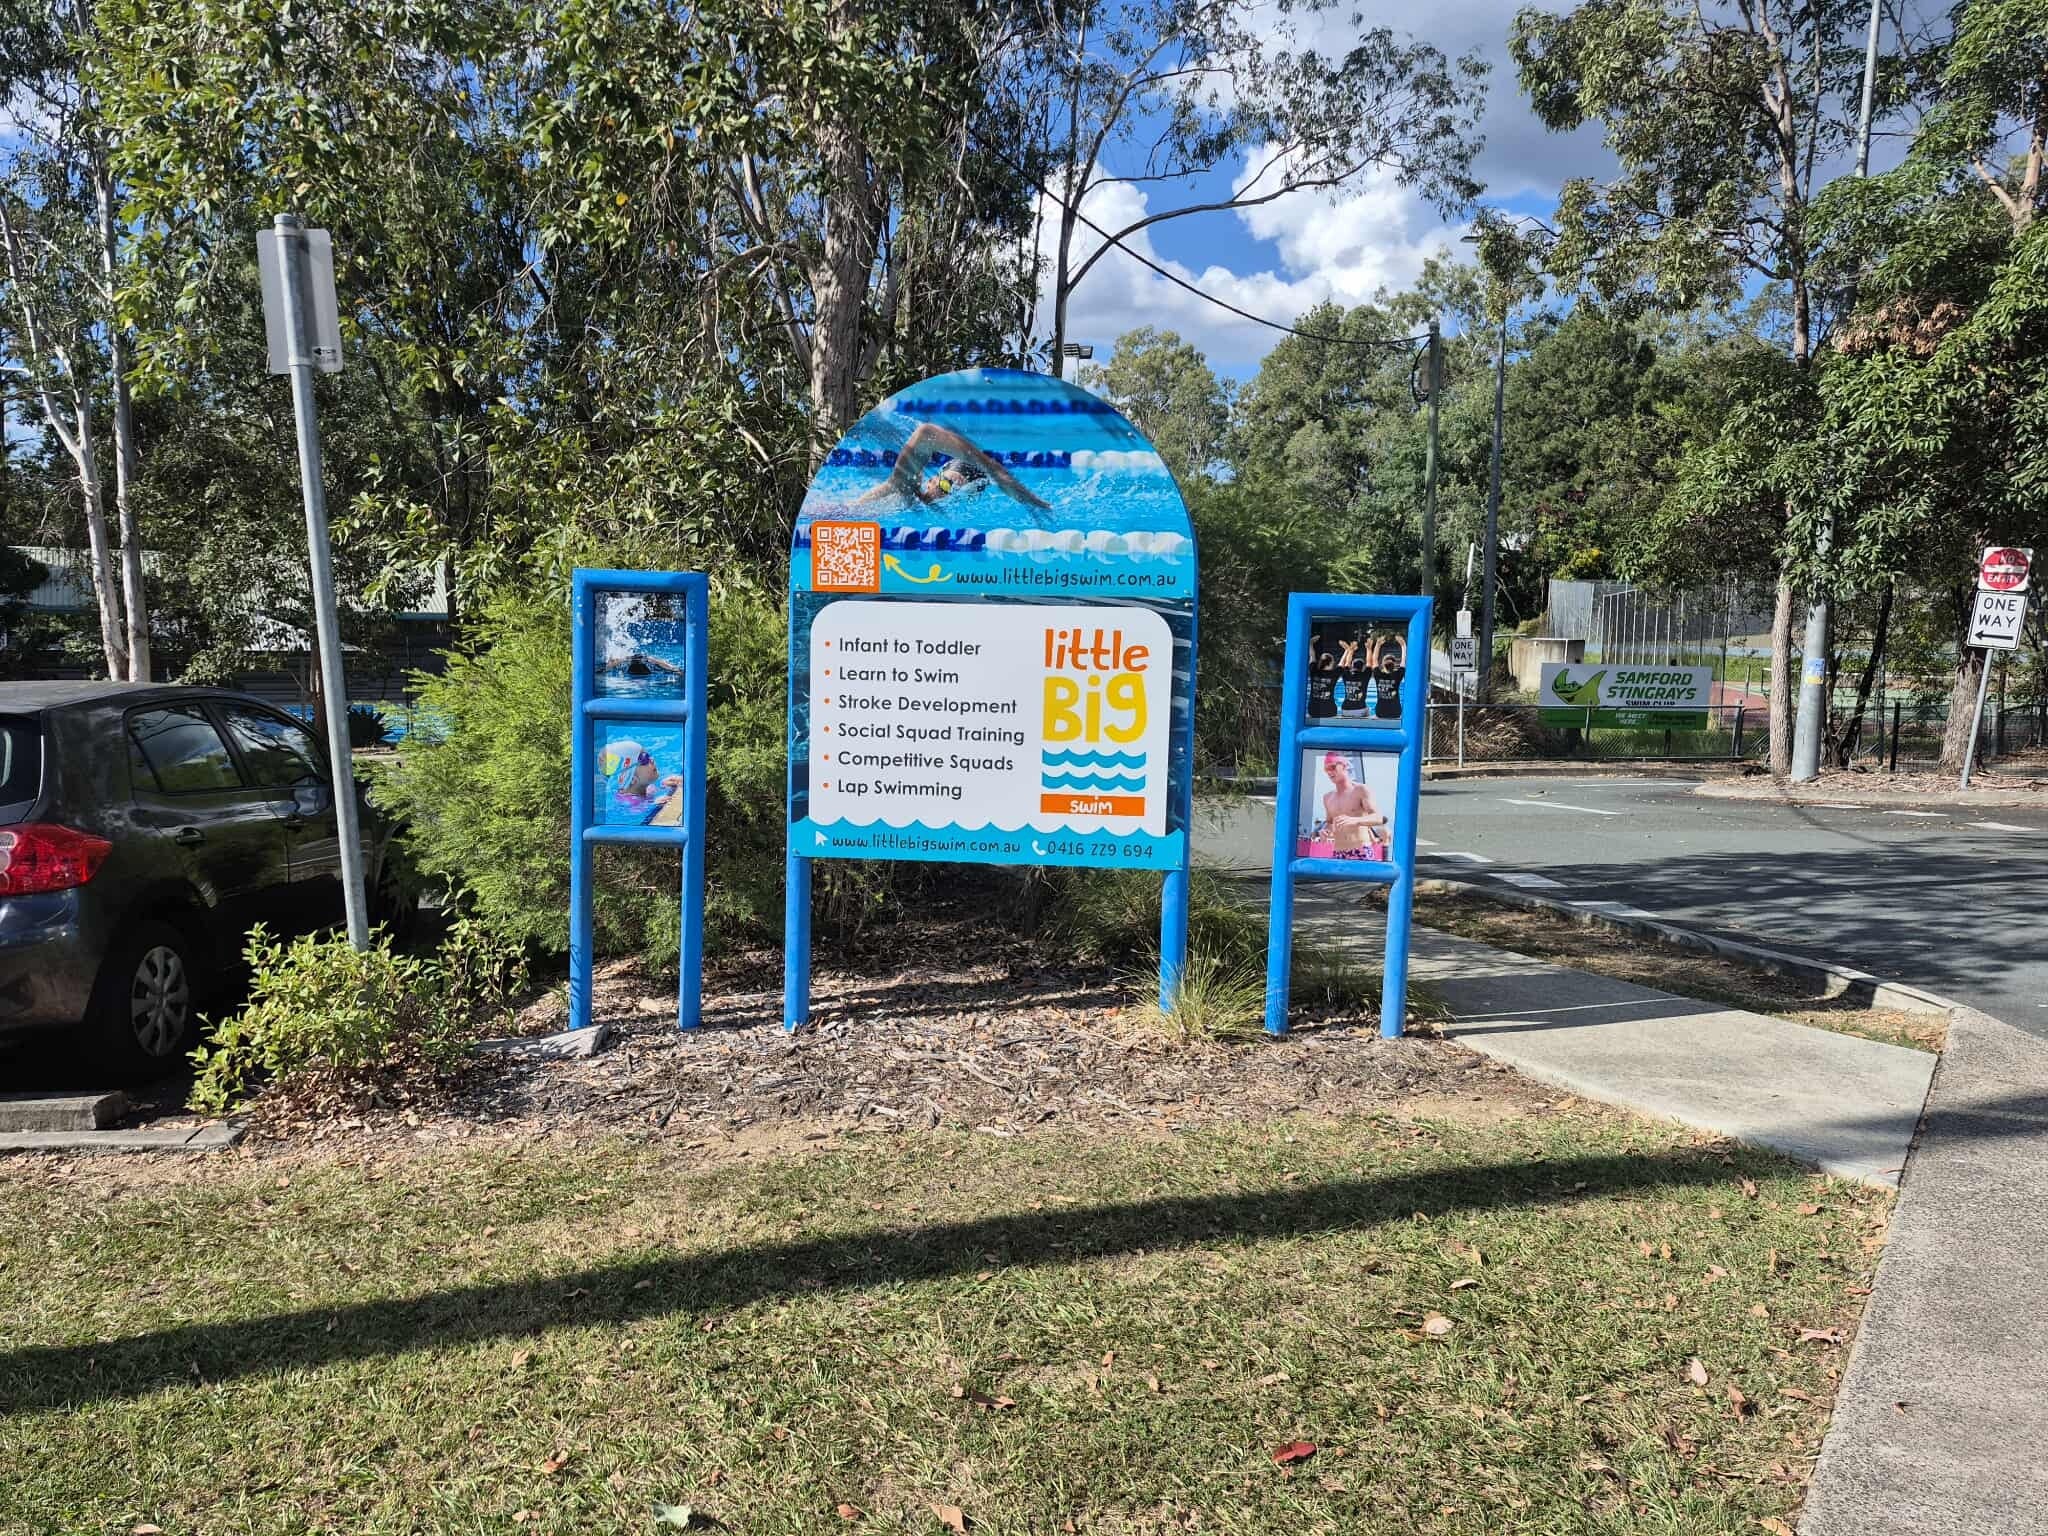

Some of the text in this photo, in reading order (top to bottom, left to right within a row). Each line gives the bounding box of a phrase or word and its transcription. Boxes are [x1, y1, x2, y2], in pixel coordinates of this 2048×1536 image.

[2000, 551, 2015, 564] NO
[956, 567, 1176, 587] www.littlebigswim.com.au
[1987, 574, 2020, 584] ENTRY
[1984, 597, 2017, 611] ONE
[1978, 614, 2016, 628] WAY
[839, 637, 982, 655] Infant to Toddler
[1044, 629, 1149, 672] little
[1454, 641, 1473, 650] ONE
[1453, 652, 1473, 660] WAY
[839, 666, 959, 684] Learn to Swim
[1615, 671, 1693, 686] SAMFORD
[1606, 686, 1697, 700] STINGRAYS
[838, 694, 1017, 715] Stroke Development
[1042, 672, 1148, 744] Big
[838, 722, 1025, 746] Social Squad Training
[838, 751, 1014, 772] Competitive Squads
[838, 779, 962, 800] Lap Swimming
[1070, 797, 1112, 814] swim
[832, 833, 1020, 852] www.littlebigswim.com.au
[1047, 841, 1153, 858] 0416 229 694
